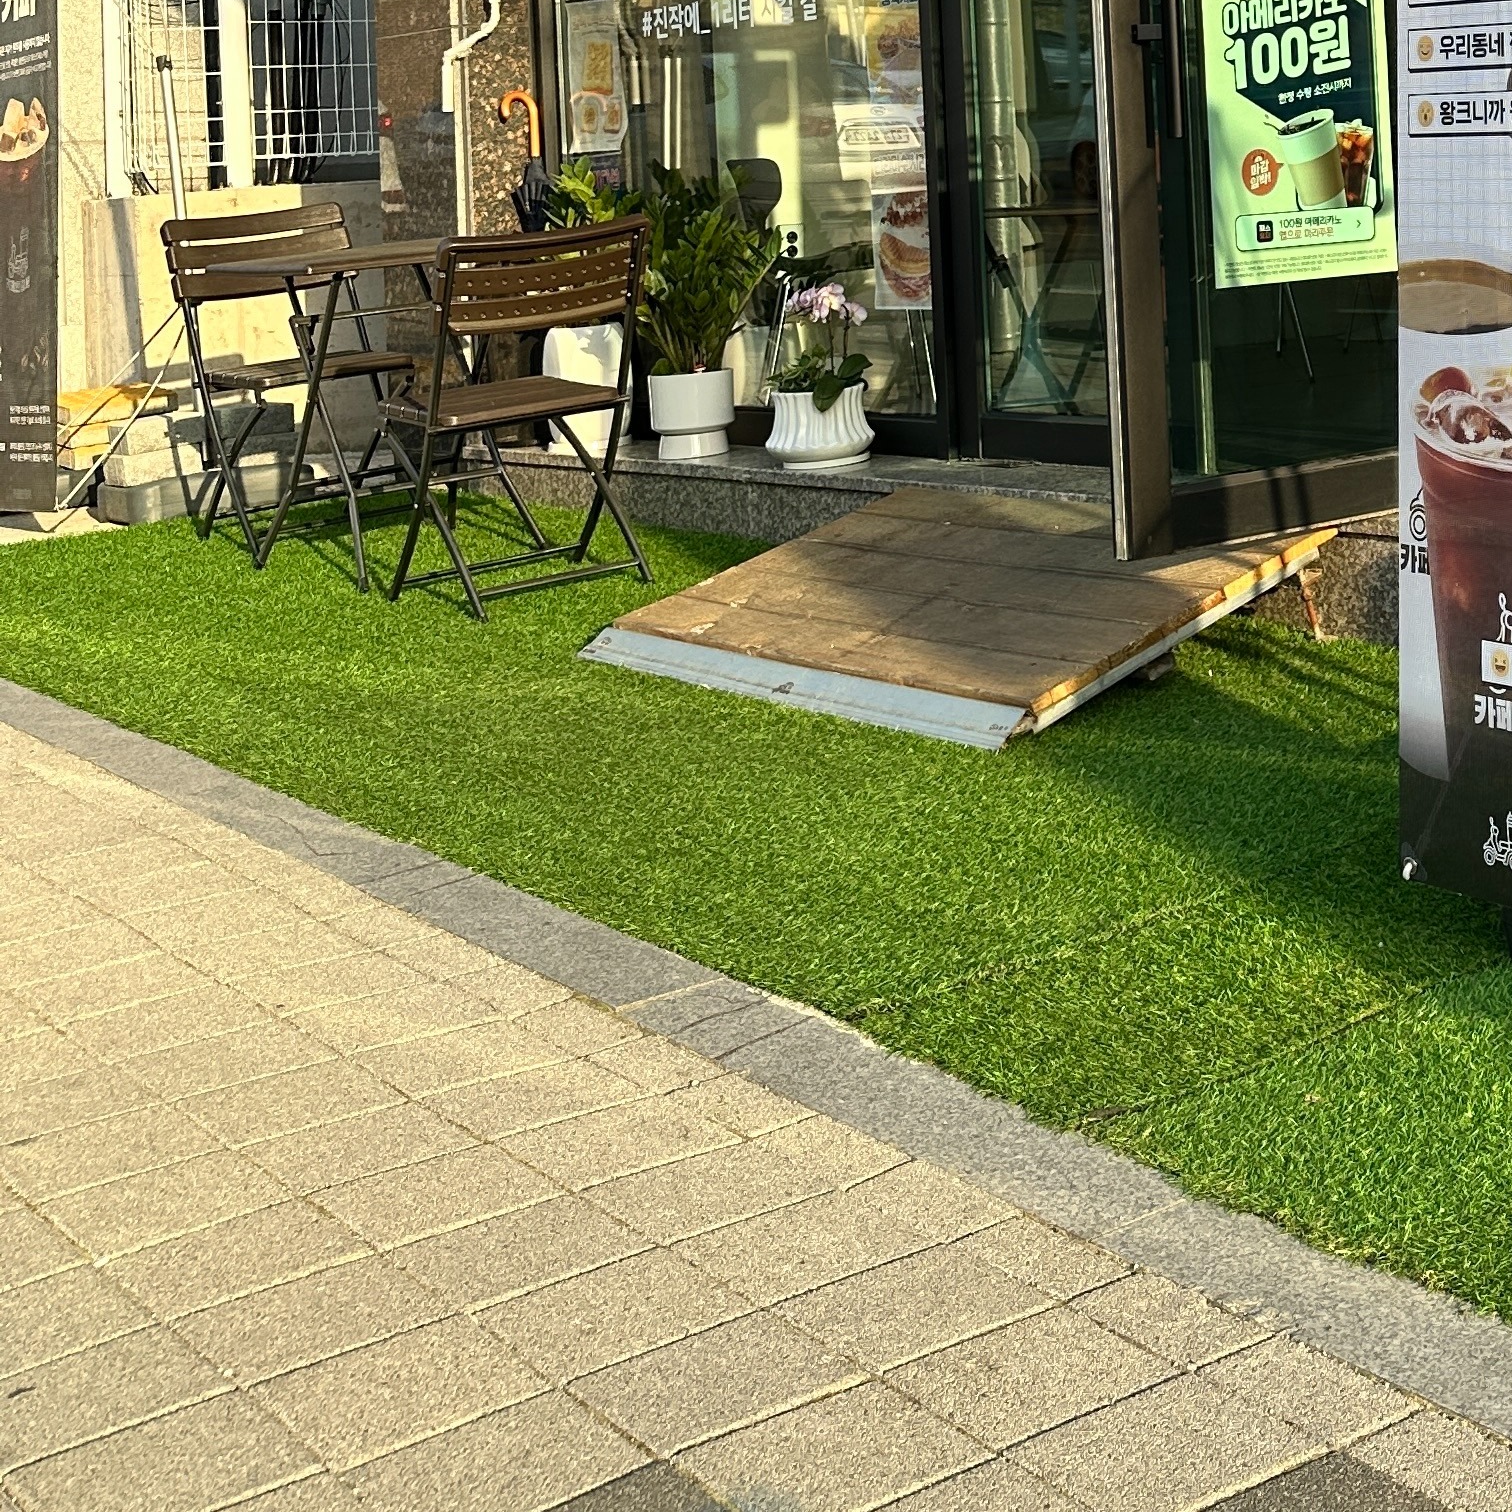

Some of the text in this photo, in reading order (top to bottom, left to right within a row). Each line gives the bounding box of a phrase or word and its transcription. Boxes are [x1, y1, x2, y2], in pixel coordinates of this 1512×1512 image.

[1227, 14, 1351, 90] 100원
[1439, 32, 1504, 60] 우리동네
[1439, 100, 1505, 126] 왕크니까
[1251, 160, 1268, 176] 마감
